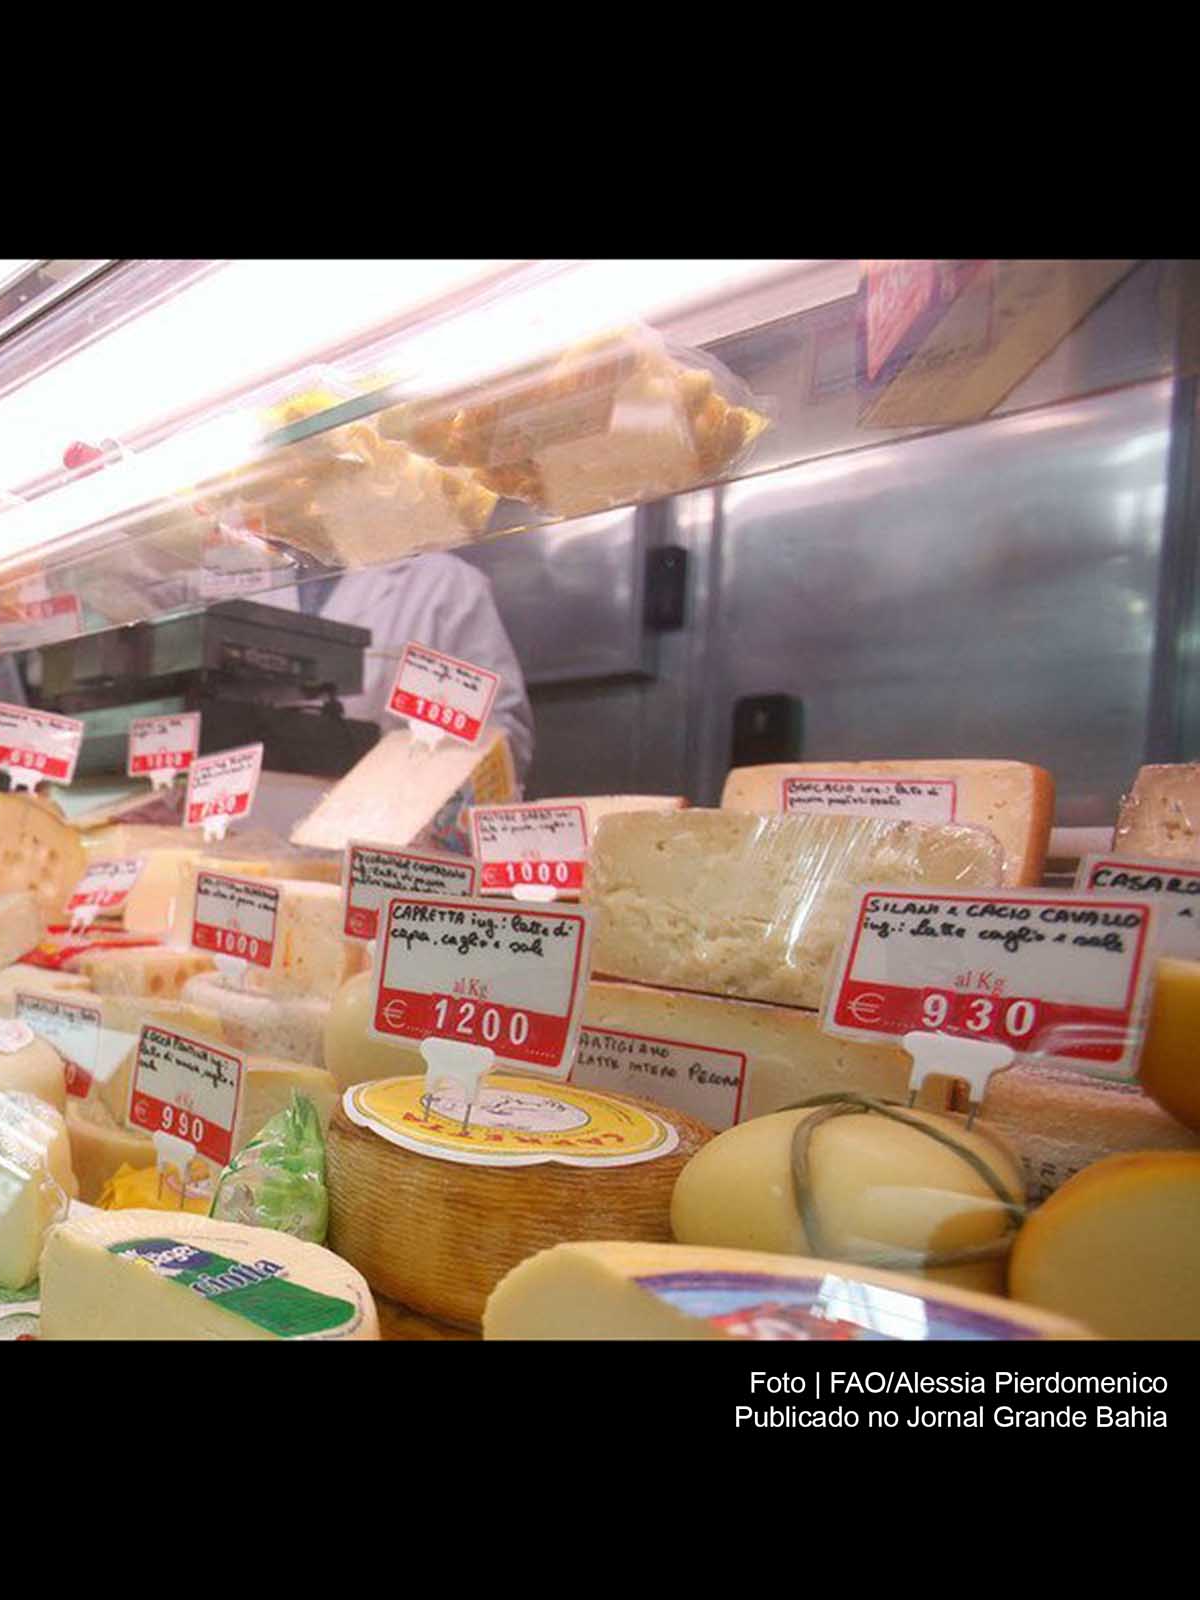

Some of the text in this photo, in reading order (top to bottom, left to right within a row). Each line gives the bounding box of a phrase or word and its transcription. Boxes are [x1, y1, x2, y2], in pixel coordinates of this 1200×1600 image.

[506, 862, 569, 883] 1000
[392, 905, 465, 927] CAPRETTA
[966, 903, 1031, 921] CACIO
[434, 998, 529, 1046] 1200
[161, 1105, 204, 1143] 990
